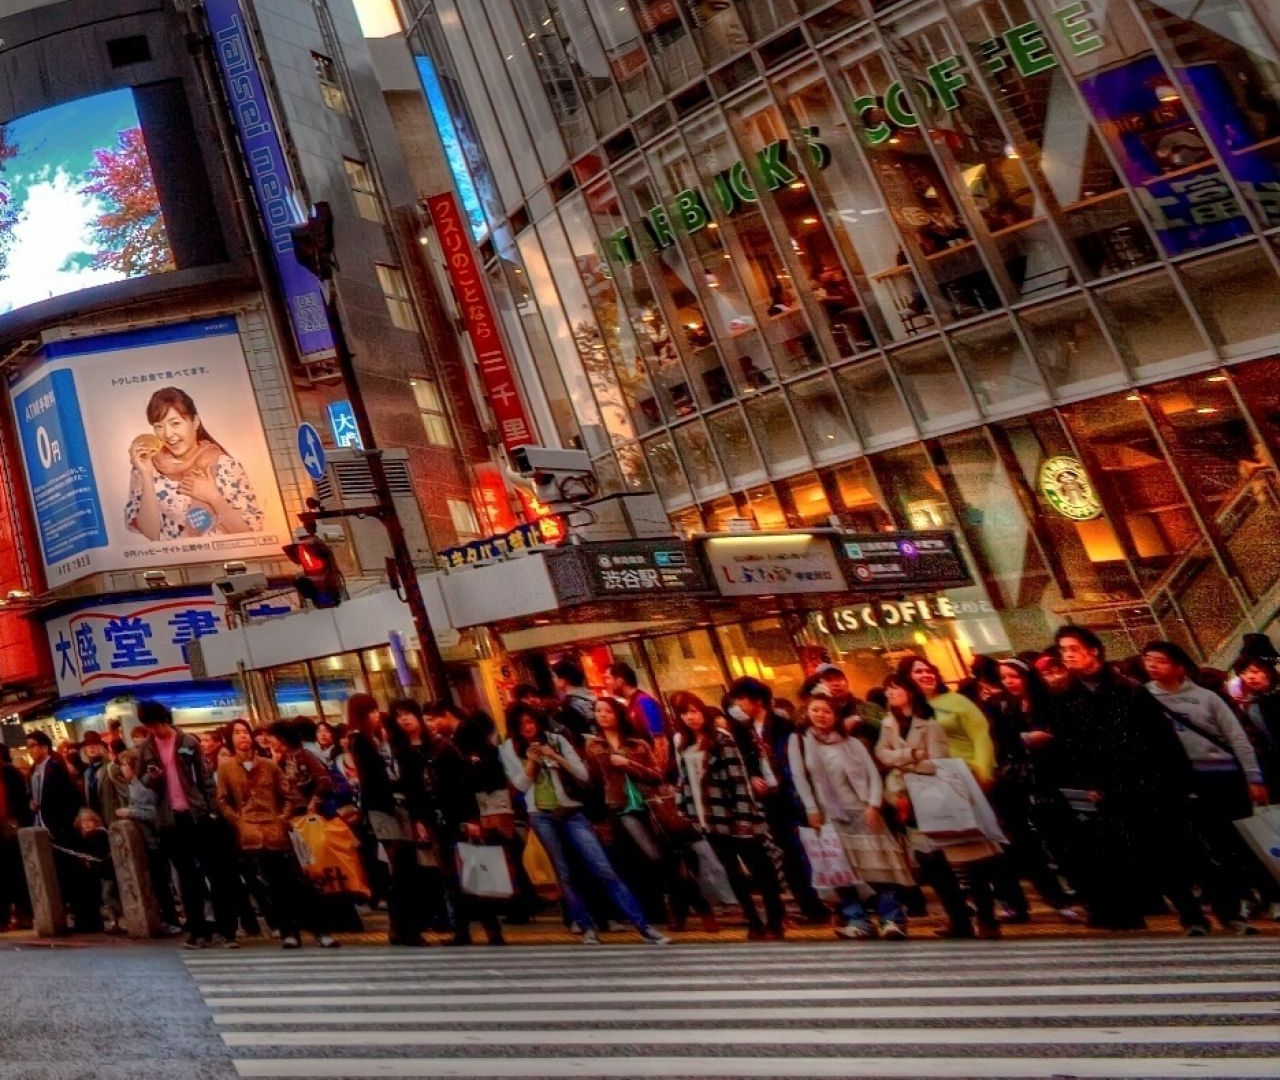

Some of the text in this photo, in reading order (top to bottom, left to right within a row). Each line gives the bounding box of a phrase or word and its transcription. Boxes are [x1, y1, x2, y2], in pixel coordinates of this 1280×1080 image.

[217, 14, 293, 255] Taisei neon
[434, 200, 529, 442] クスリのことなら 三千里
[603, 569, 659, 590] 渋谷駅
